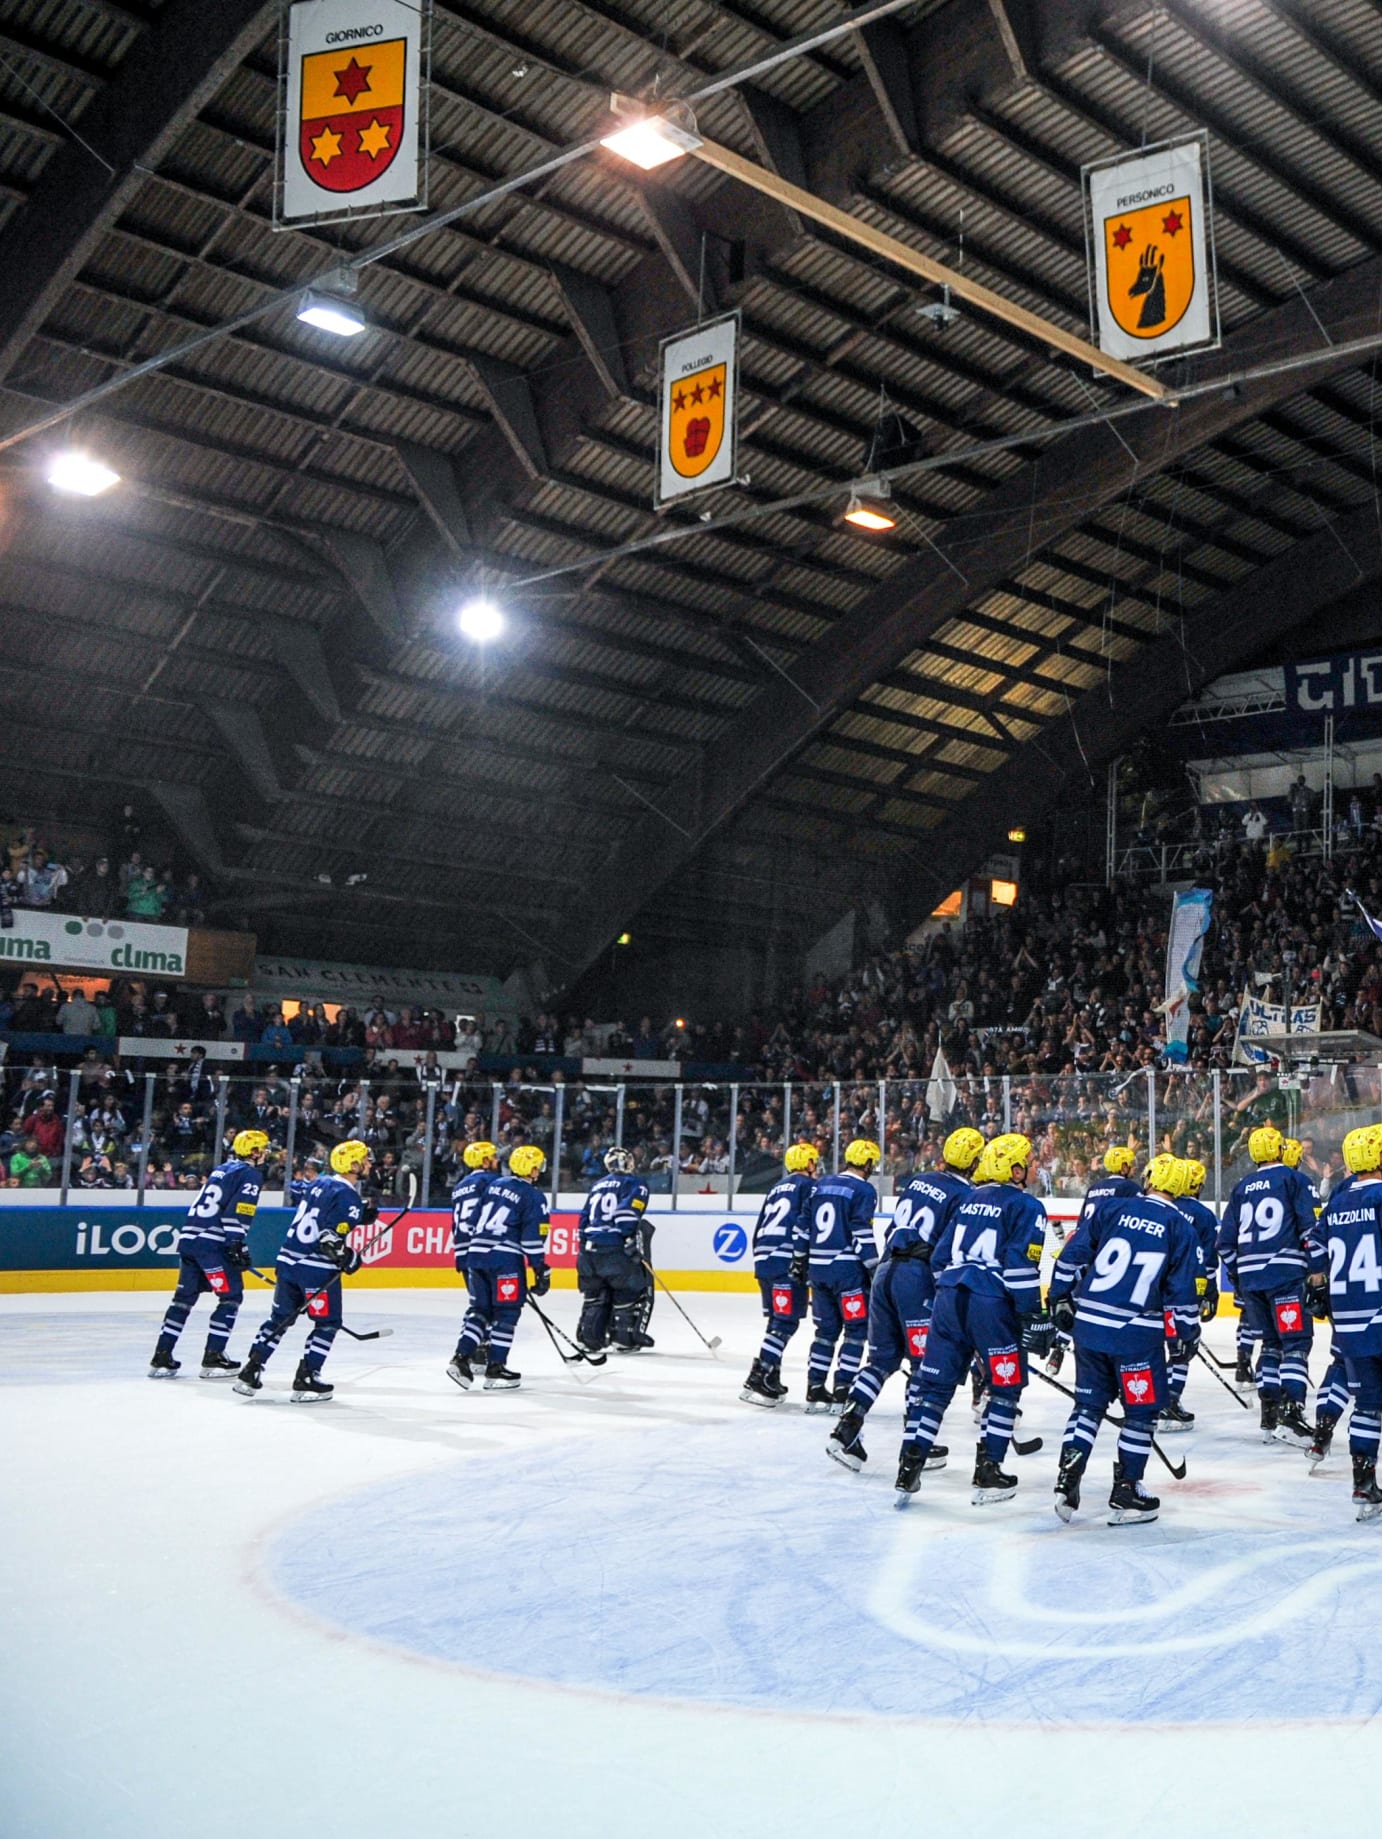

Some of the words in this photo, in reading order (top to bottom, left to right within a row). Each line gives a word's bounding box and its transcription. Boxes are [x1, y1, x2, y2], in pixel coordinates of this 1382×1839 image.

[325, 24, 384, 44] GIORNICO
[1117, 183, 1175, 208] PERSONICO
[111, 944, 183, 972] clima
[242, 1183, 260, 1197] 23
[908, 1180, 947, 1204] FISCHER
[1245, 1180, 1271, 1194] FORA
[286, 1200, 322, 1244] 26
[476, 1201, 511, 1236] 14
[815, 1202, 836, 1244] 9
[1118, 1214, 1165, 1238] HOFER
[1238, 1197, 1284, 1244] 29
[76, 1222, 181, 1255] iLOQ
[717, 1229, 743, 1259] Z
[1088, 1237, 1166, 1307] 97
[1328, 1233, 1382, 1295] 24
